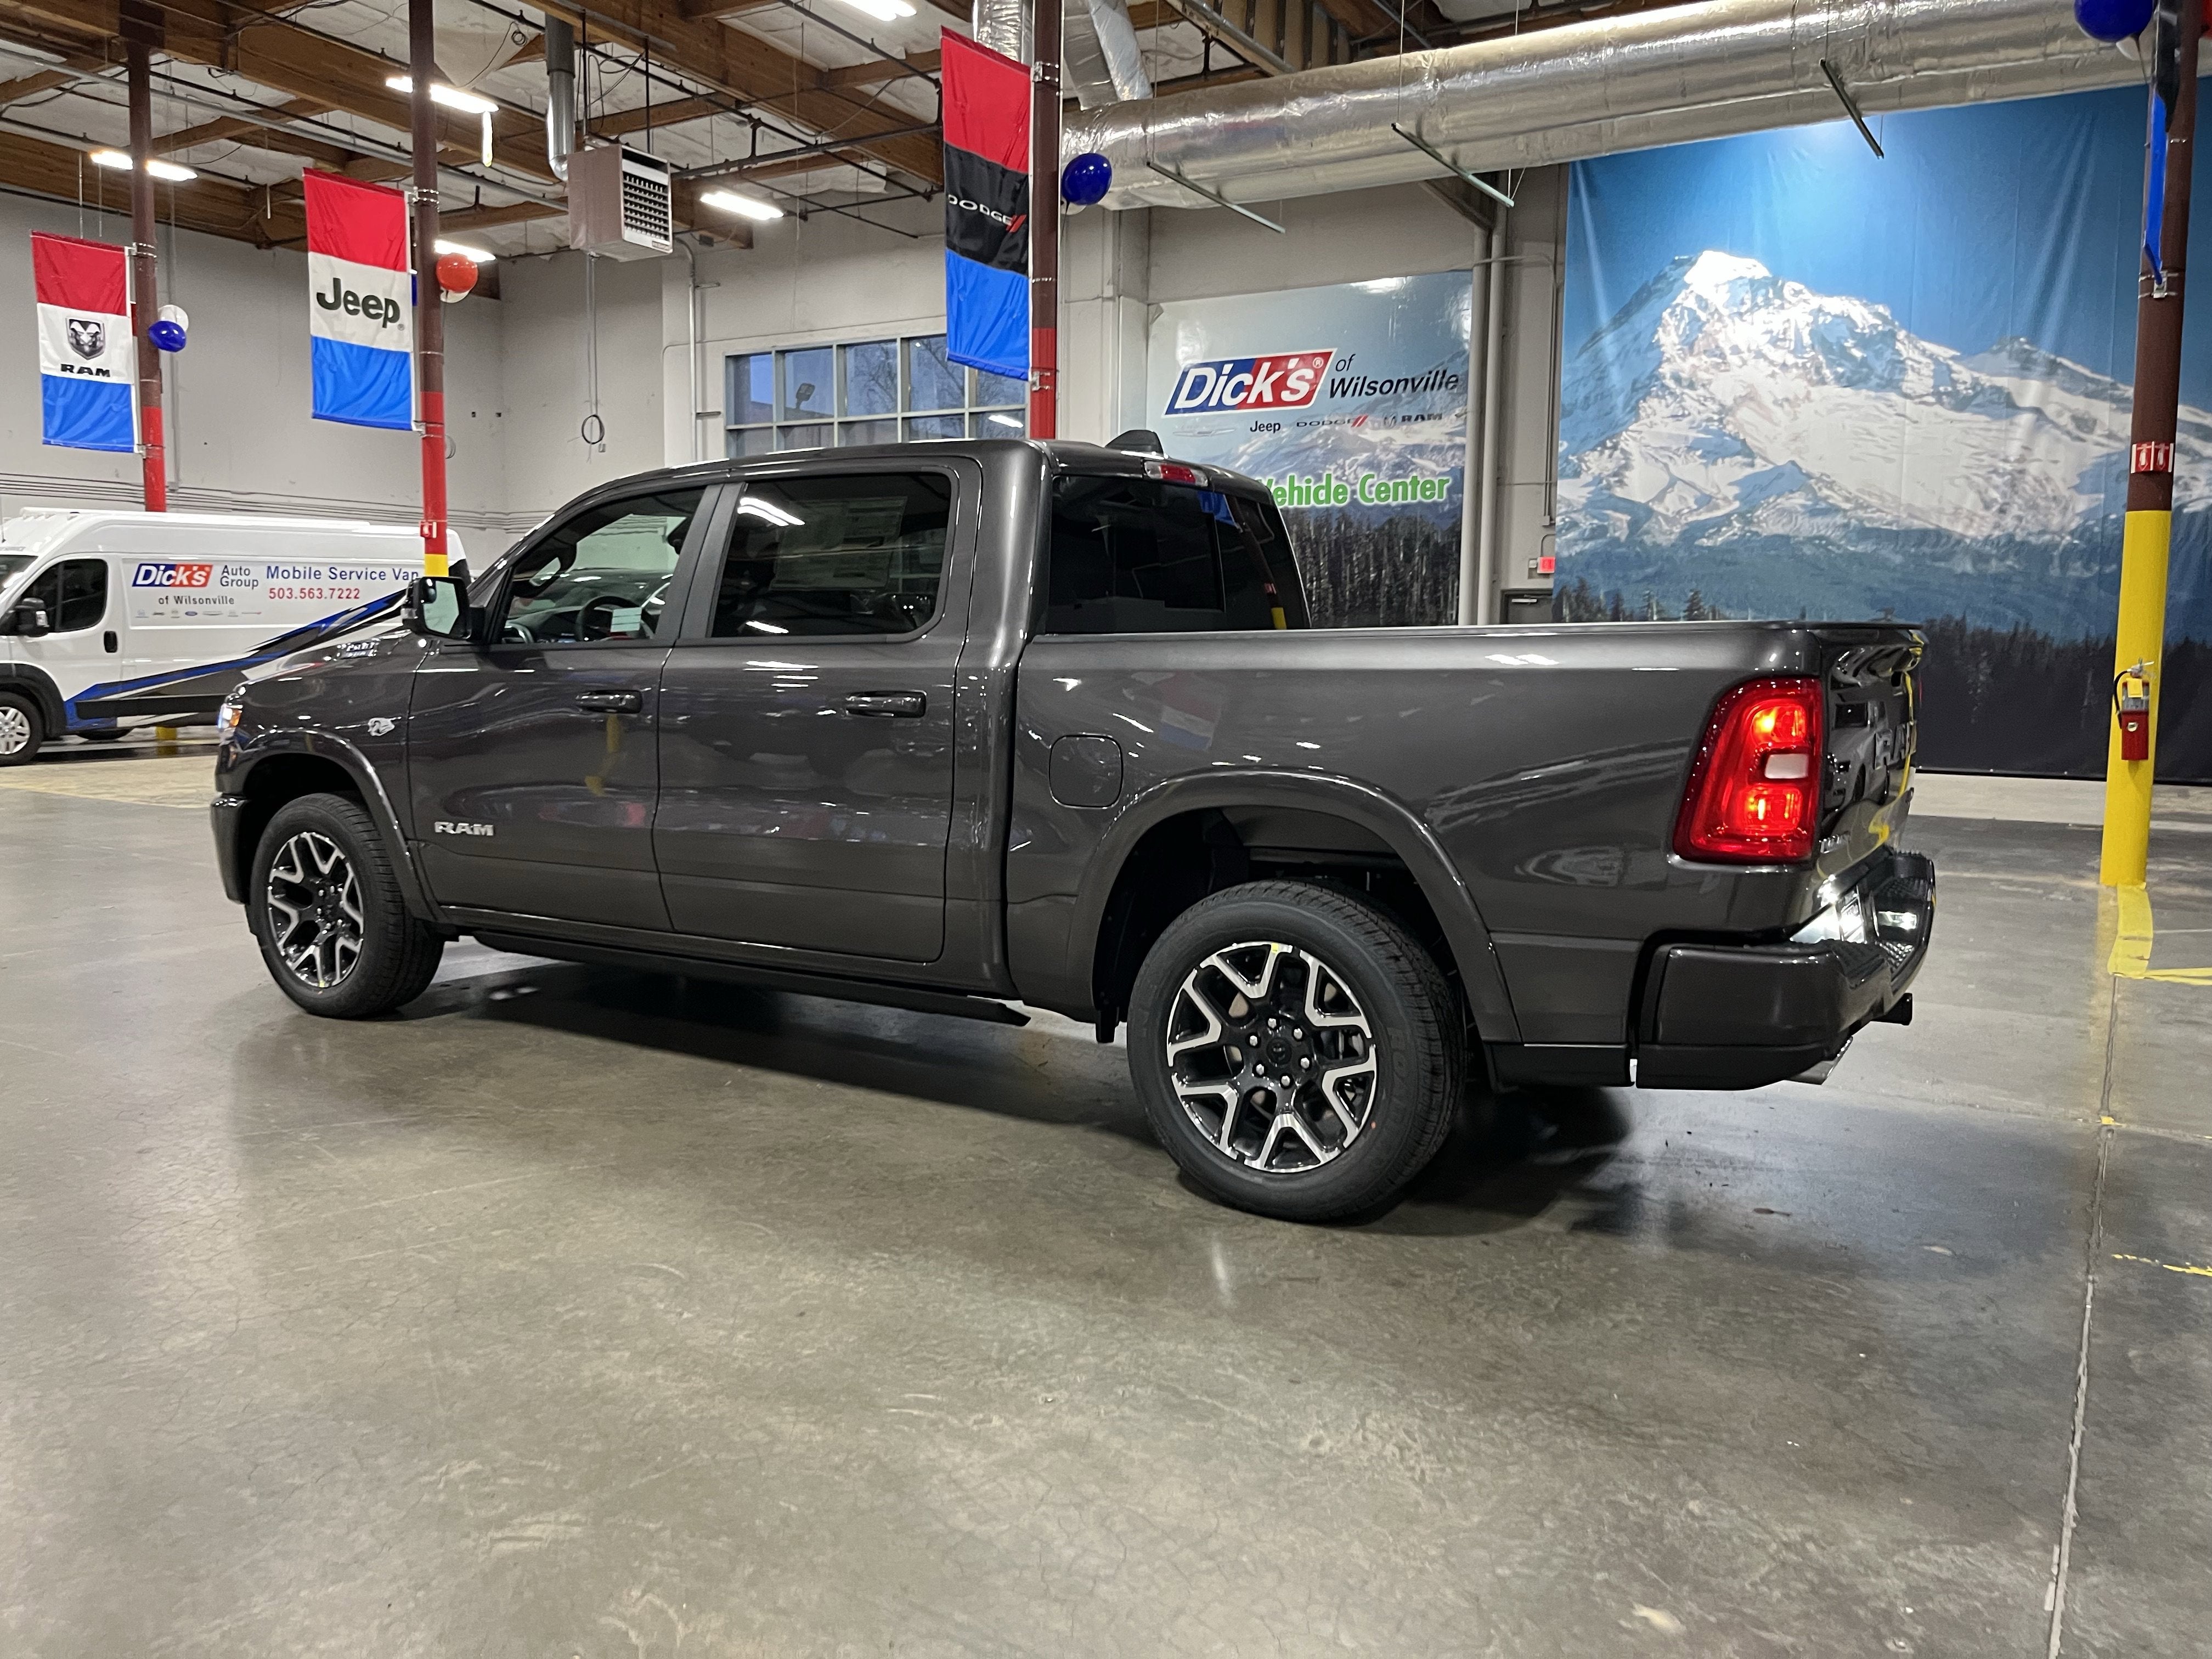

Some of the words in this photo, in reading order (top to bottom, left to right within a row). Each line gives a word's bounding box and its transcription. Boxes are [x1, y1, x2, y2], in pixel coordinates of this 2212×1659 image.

[948, 194, 1013, 226] DODGE
[316, 277, 400, 329] Jeep
[60, 363, 110, 377] RAM
[1174, 358, 1314, 409] Dick's
[1335, 354, 1356, 372] of
[1329, 368, 1459, 399] Wilsonville
[1250, 420, 1281, 433] Jeep
[1401, 413, 1443, 423] RAM
[1359, 474, 1450, 503] Center
[221, 565, 251, 576] Auto
[266, 566, 322, 580] Mobile
[328, 567, 387, 580] Service
[392, 568, 419, 580] Van
[220, 575, 259, 590] Group
[158, 595, 169, 605] of
[173, 595, 235, 605] Wilsonville
[268, 588, 360, 600] 503.563.7222
[434, 821, 494, 836] RAM
